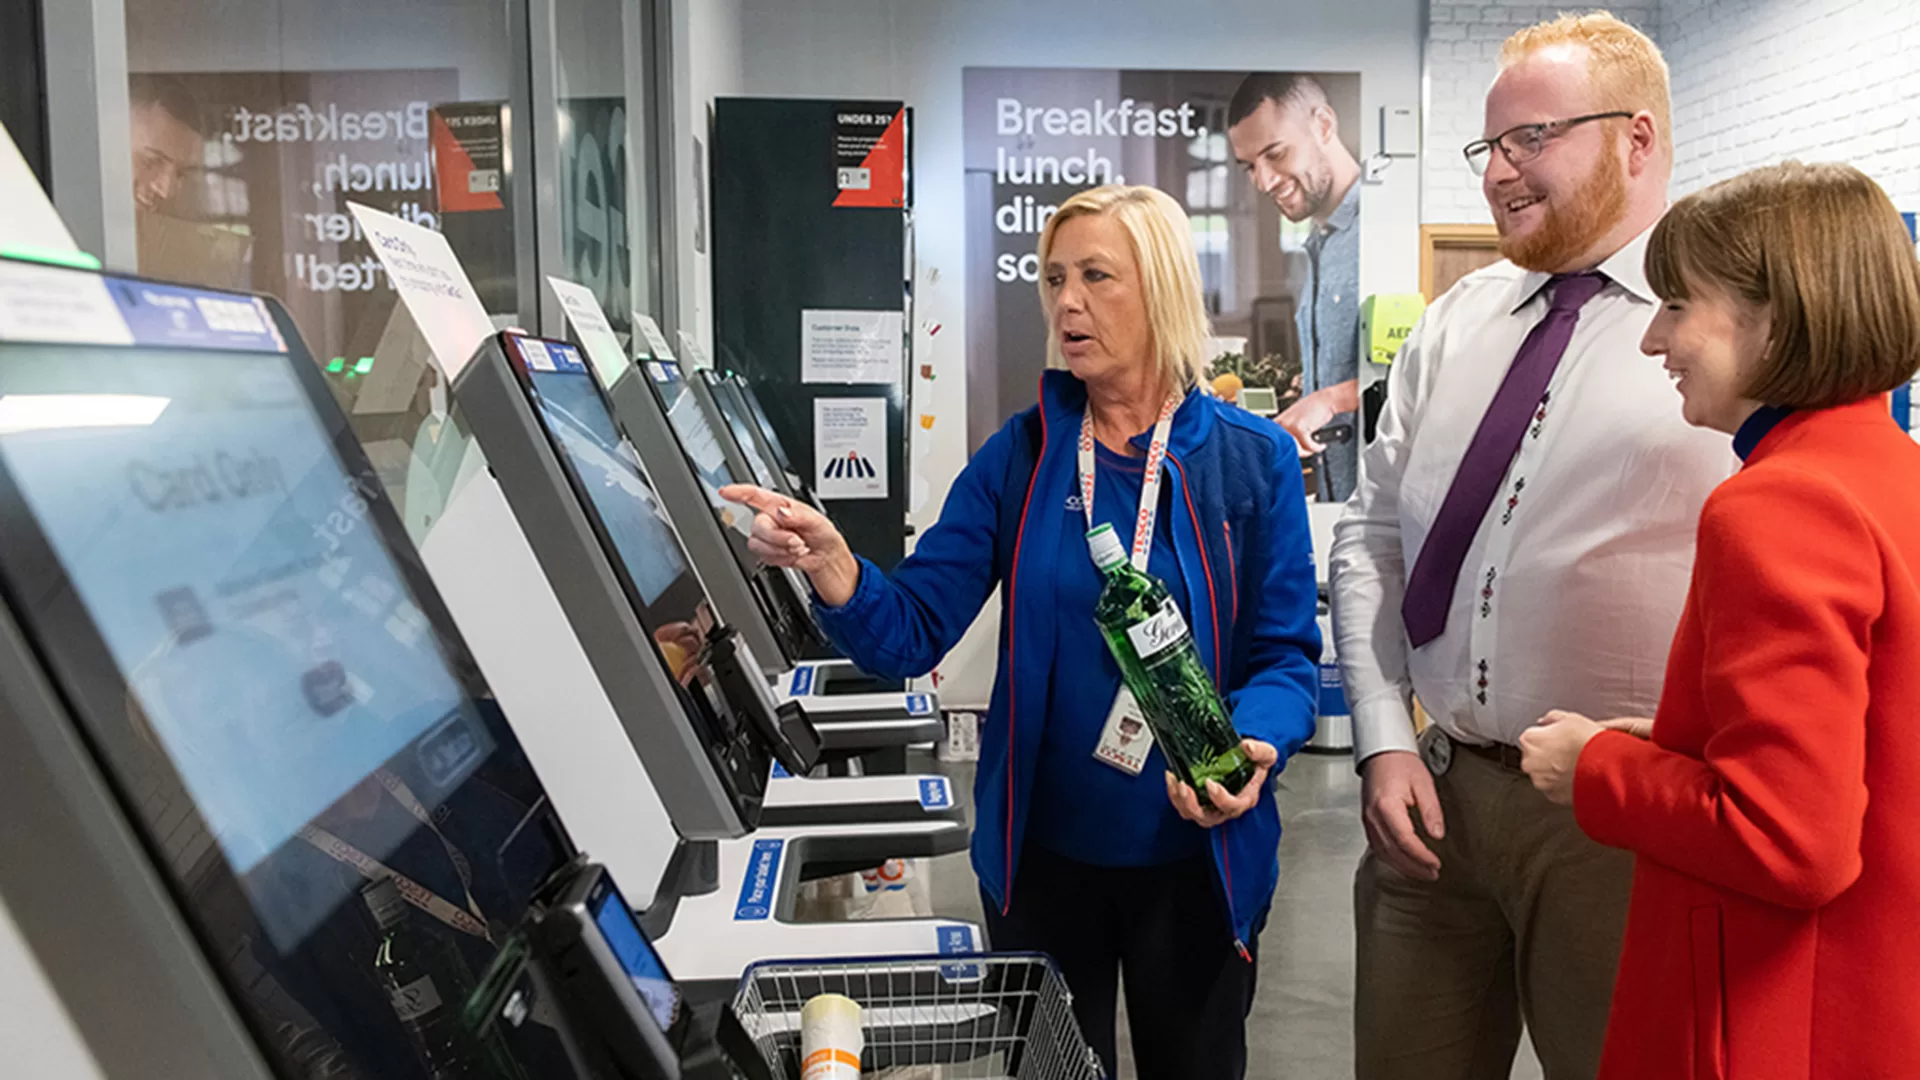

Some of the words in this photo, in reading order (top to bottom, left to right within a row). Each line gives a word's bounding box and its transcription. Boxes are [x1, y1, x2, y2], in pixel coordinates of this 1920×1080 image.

[837, 113, 873, 124] UNDER
[996, 98, 1208, 141] Breakfast,
[995, 252, 1040, 282] so
[1144, 439, 1160, 485] TESCO
[1134, 508, 1149, 554] TESCO
